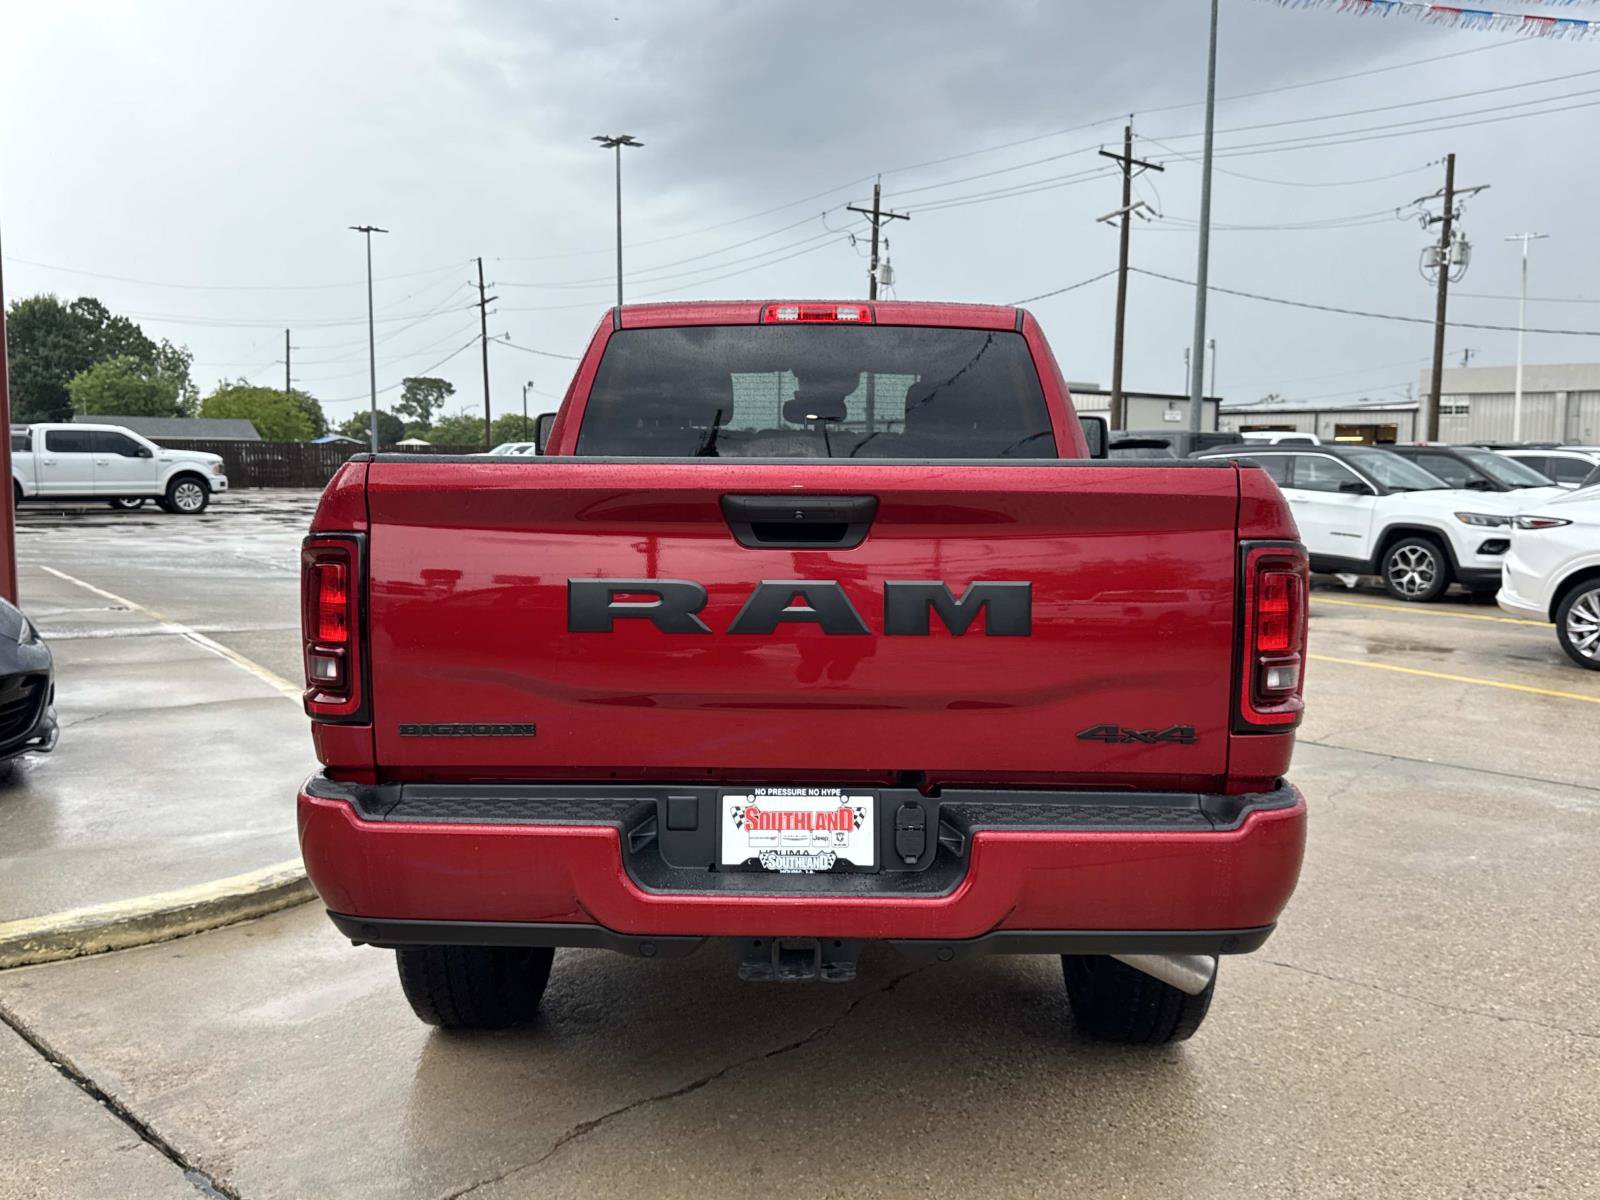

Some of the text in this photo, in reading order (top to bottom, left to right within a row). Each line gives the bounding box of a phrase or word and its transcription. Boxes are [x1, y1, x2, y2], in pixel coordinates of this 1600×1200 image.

[567, 578, 1033, 636] RAM
[399, 722, 536, 737] BIGHORN
[754, 788, 841, 797] NO PRESSURE NO HYPE
[744, 806, 854, 832] SOUTHLAND
[767, 854, 829, 870] SOUTHLAND
